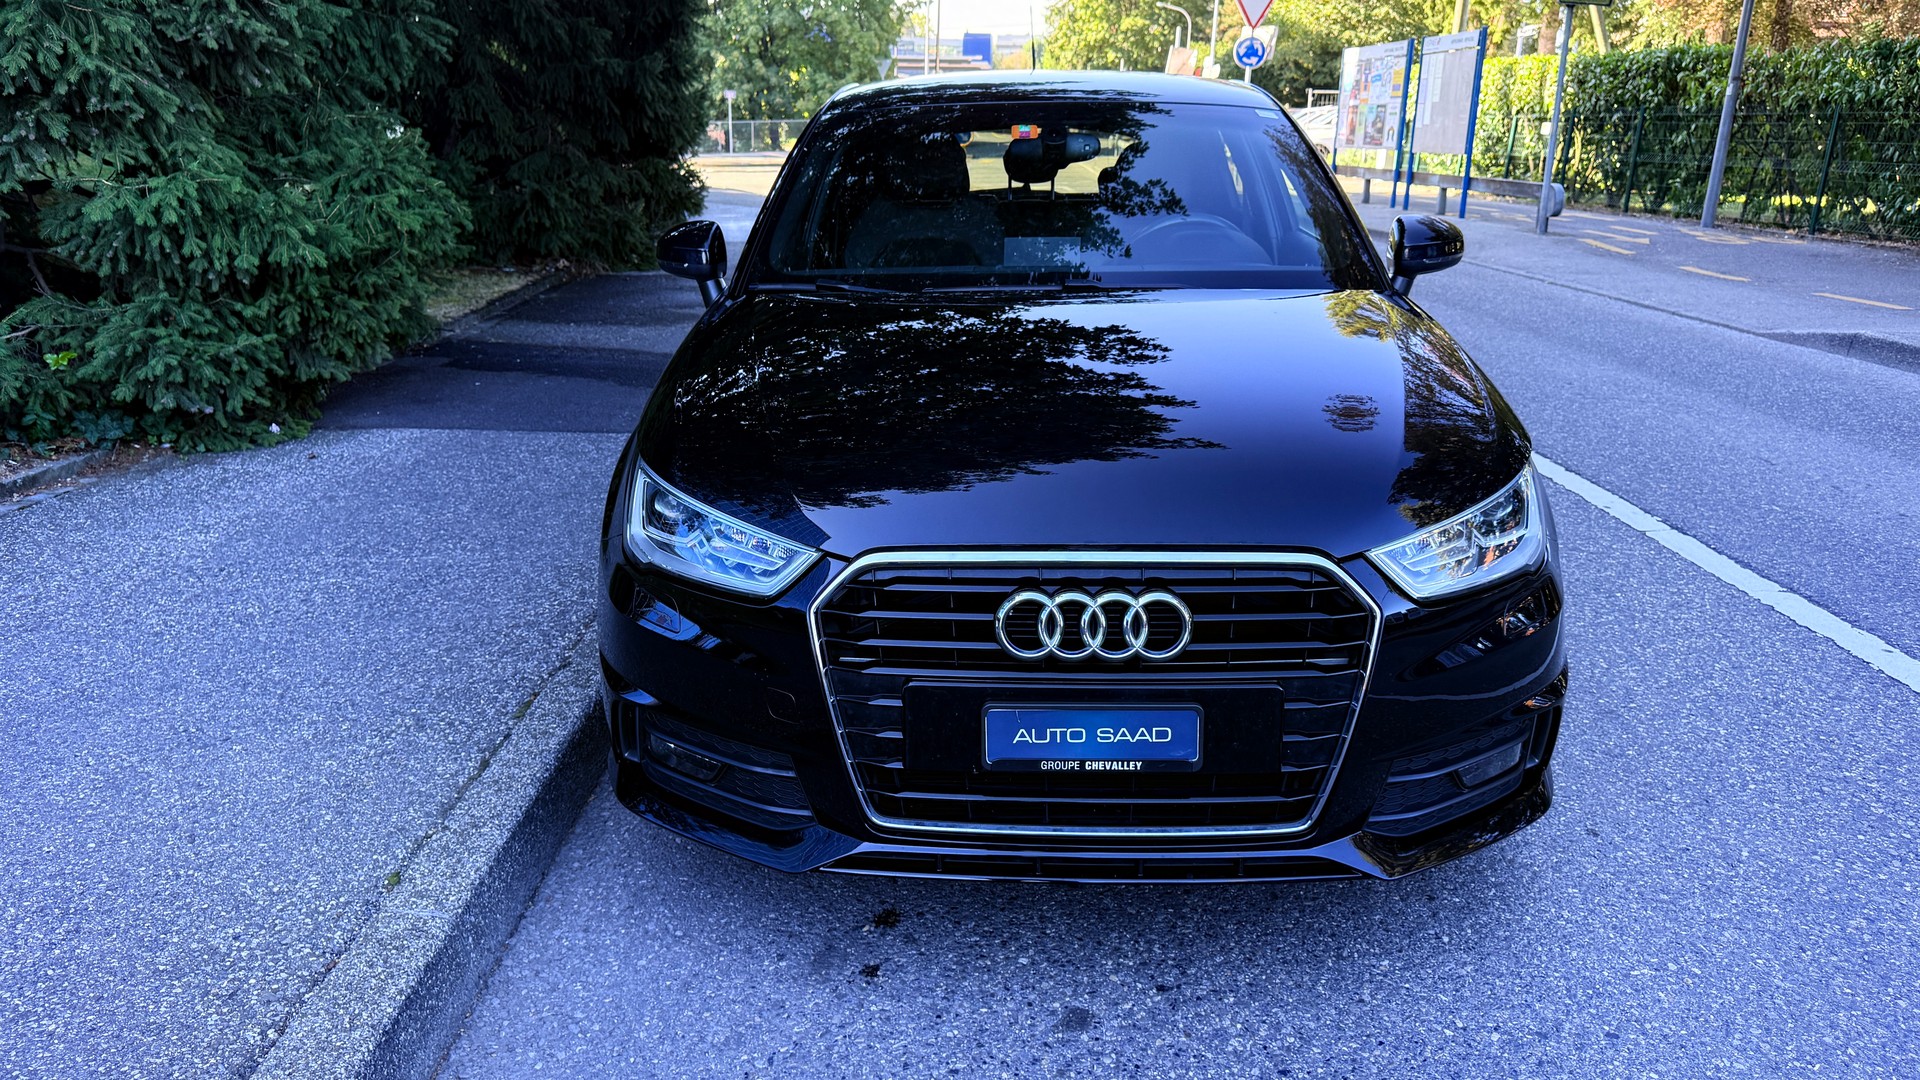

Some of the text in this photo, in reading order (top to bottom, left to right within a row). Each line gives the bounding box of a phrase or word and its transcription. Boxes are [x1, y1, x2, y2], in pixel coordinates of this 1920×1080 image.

[1013, 727, 1172, 744] AUTO SAAD
[1040, 760, 1143, 771] GROUPE CHEVALLEY
